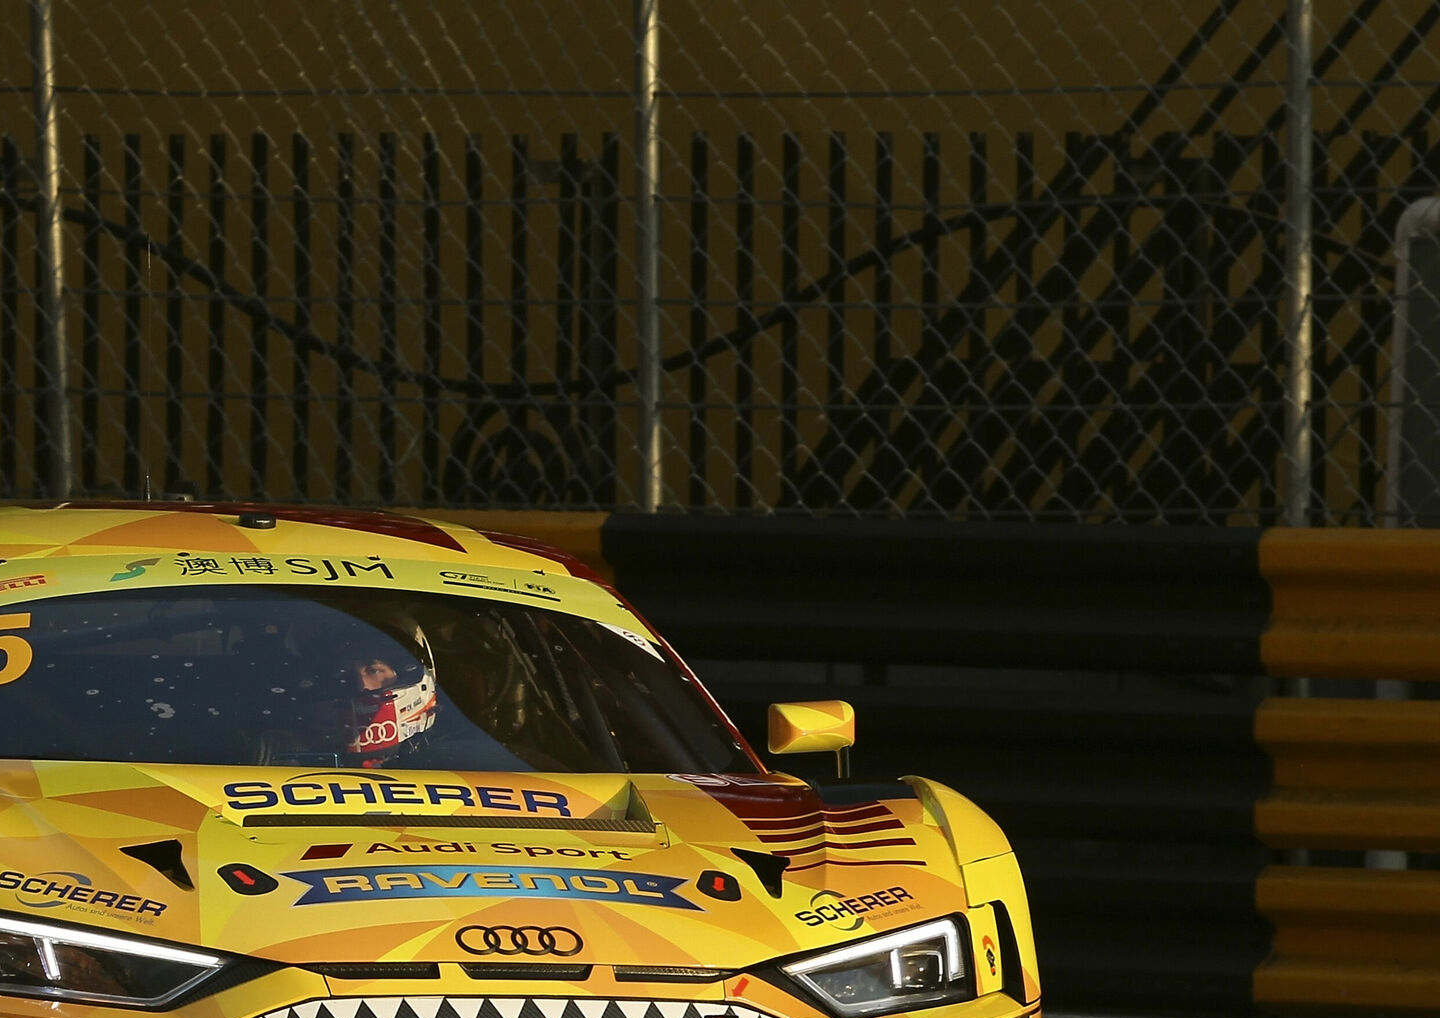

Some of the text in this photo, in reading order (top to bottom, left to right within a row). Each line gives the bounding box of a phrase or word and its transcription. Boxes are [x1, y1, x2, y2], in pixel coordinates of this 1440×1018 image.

[174, 556, 278, 576] 澳博
[287, 557, 394, 582] SJM
[224, 781, 570, 816] SCHERER
[368, 841, 631, 861] Audi Sport
[323, 873, 665, 899] RAVENOL
[795, 887, 914, 926] SCHERER
